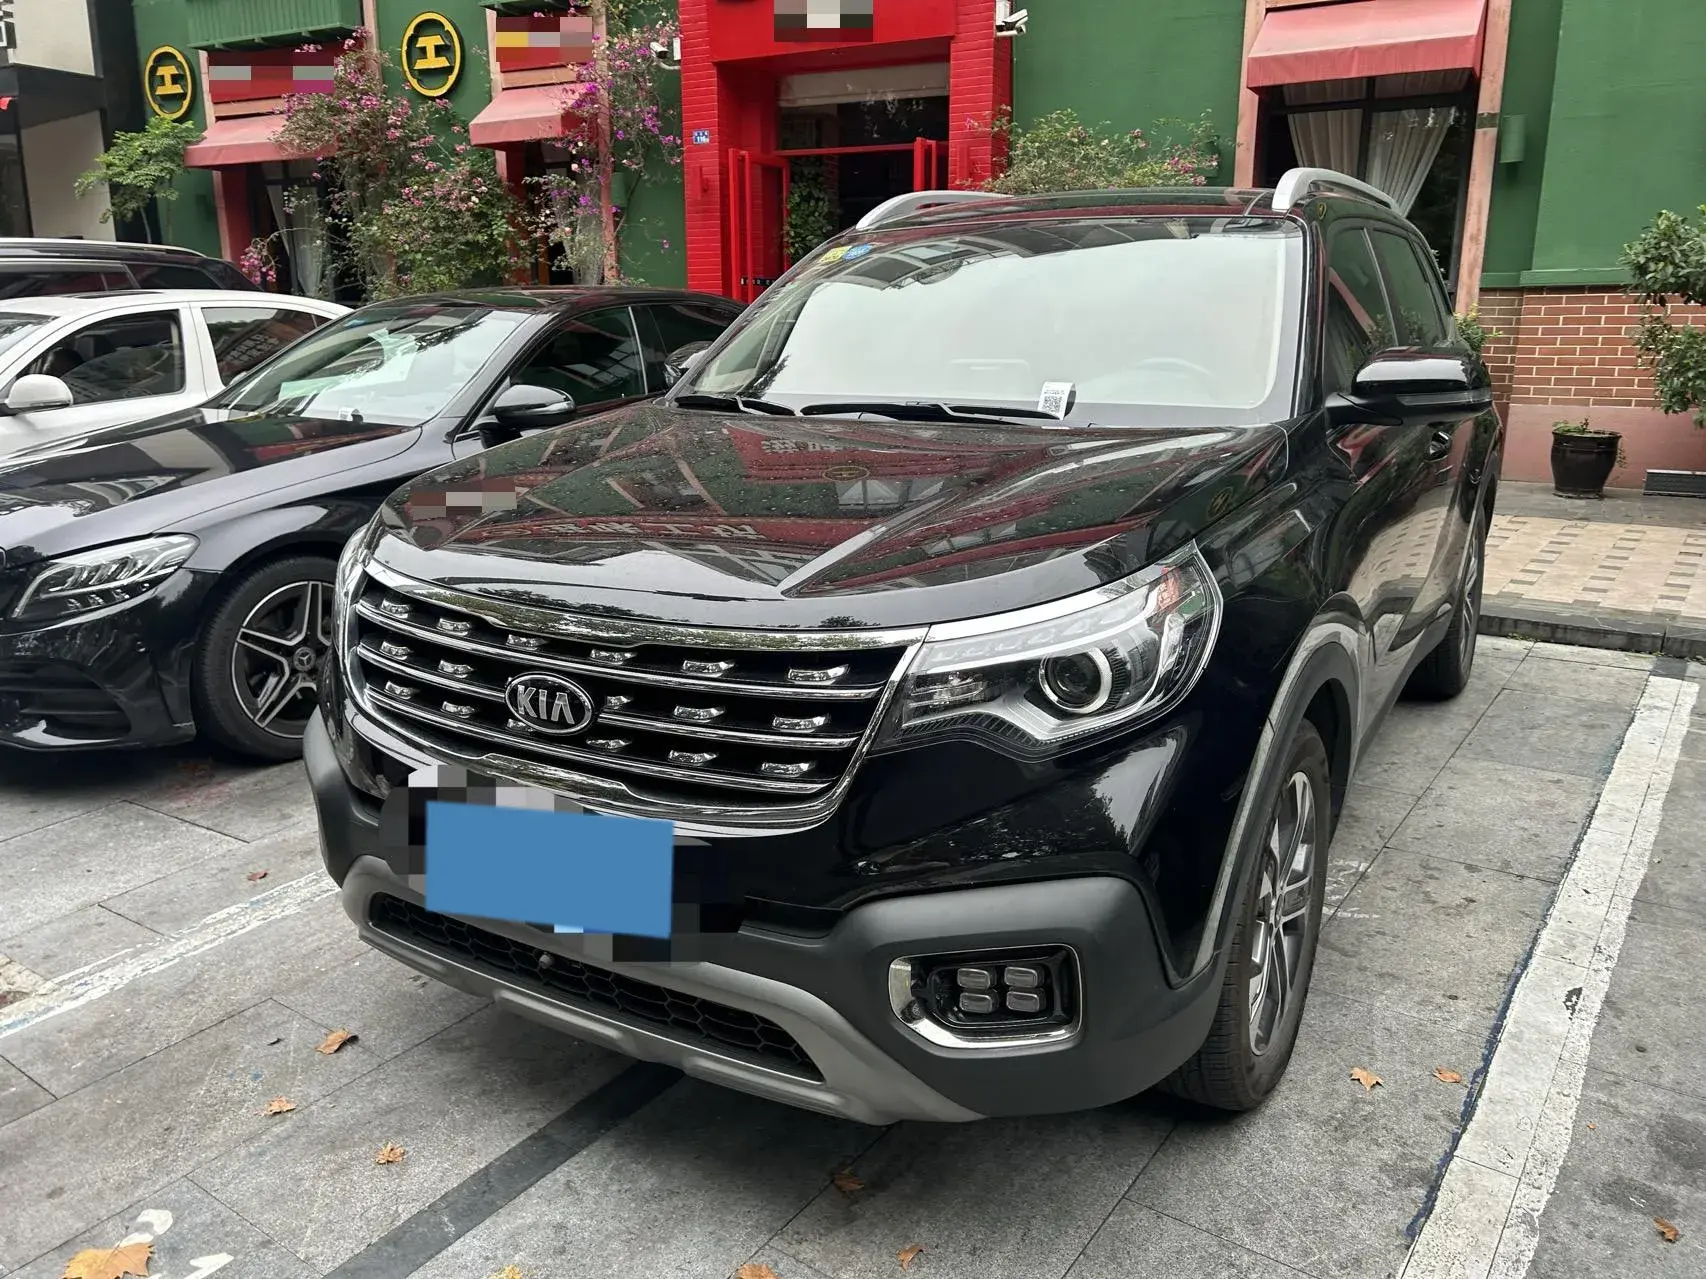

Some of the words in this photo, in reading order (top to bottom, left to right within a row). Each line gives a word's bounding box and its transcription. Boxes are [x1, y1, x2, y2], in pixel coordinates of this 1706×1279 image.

[413, 34, 451, 69] 工
[155, 65, 184, 95] 工
[517, 684, 575, 725] KIA
